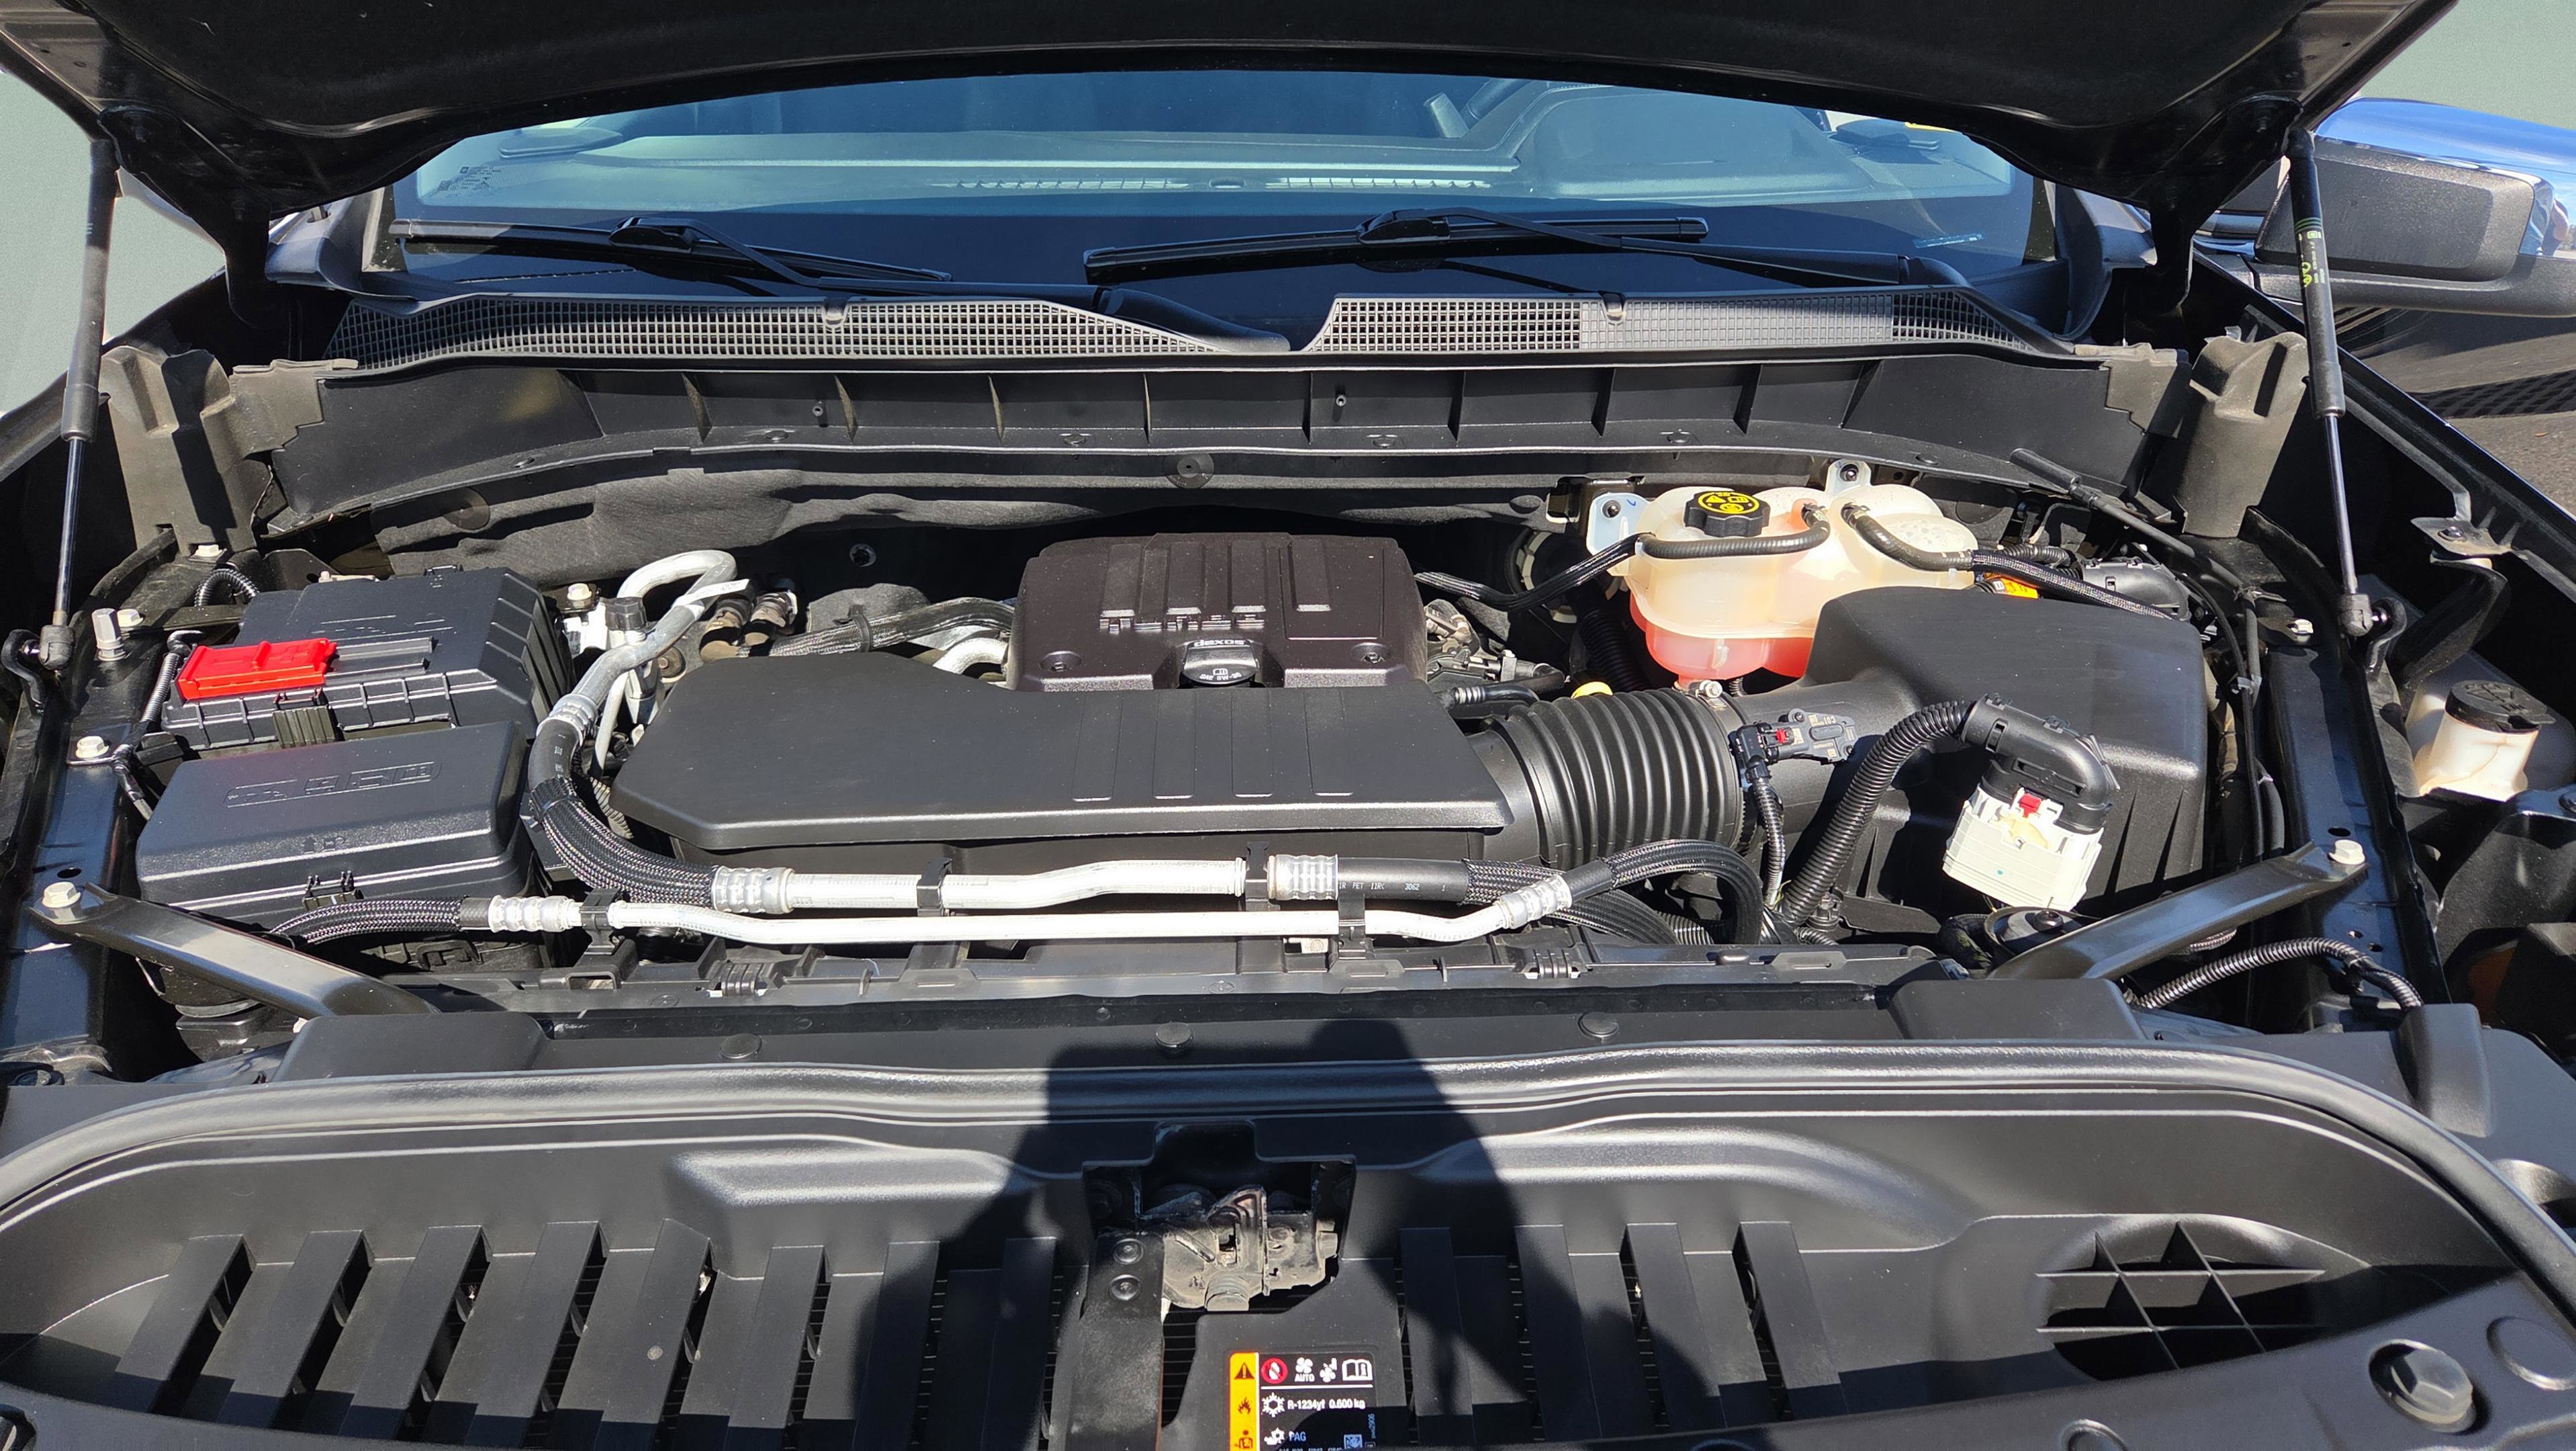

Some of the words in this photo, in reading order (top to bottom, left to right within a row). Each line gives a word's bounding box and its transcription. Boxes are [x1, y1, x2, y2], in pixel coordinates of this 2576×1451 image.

[1295, 1374, 1315, 1382] AUTO
[1287, 1399, 1325, 1411] R-1234yf
[1329, 1399, 1353, 1409] 0.600
[1354, 1399, 1365, 1409] kg
[1289, 1432, 1306, 1442] PAG
